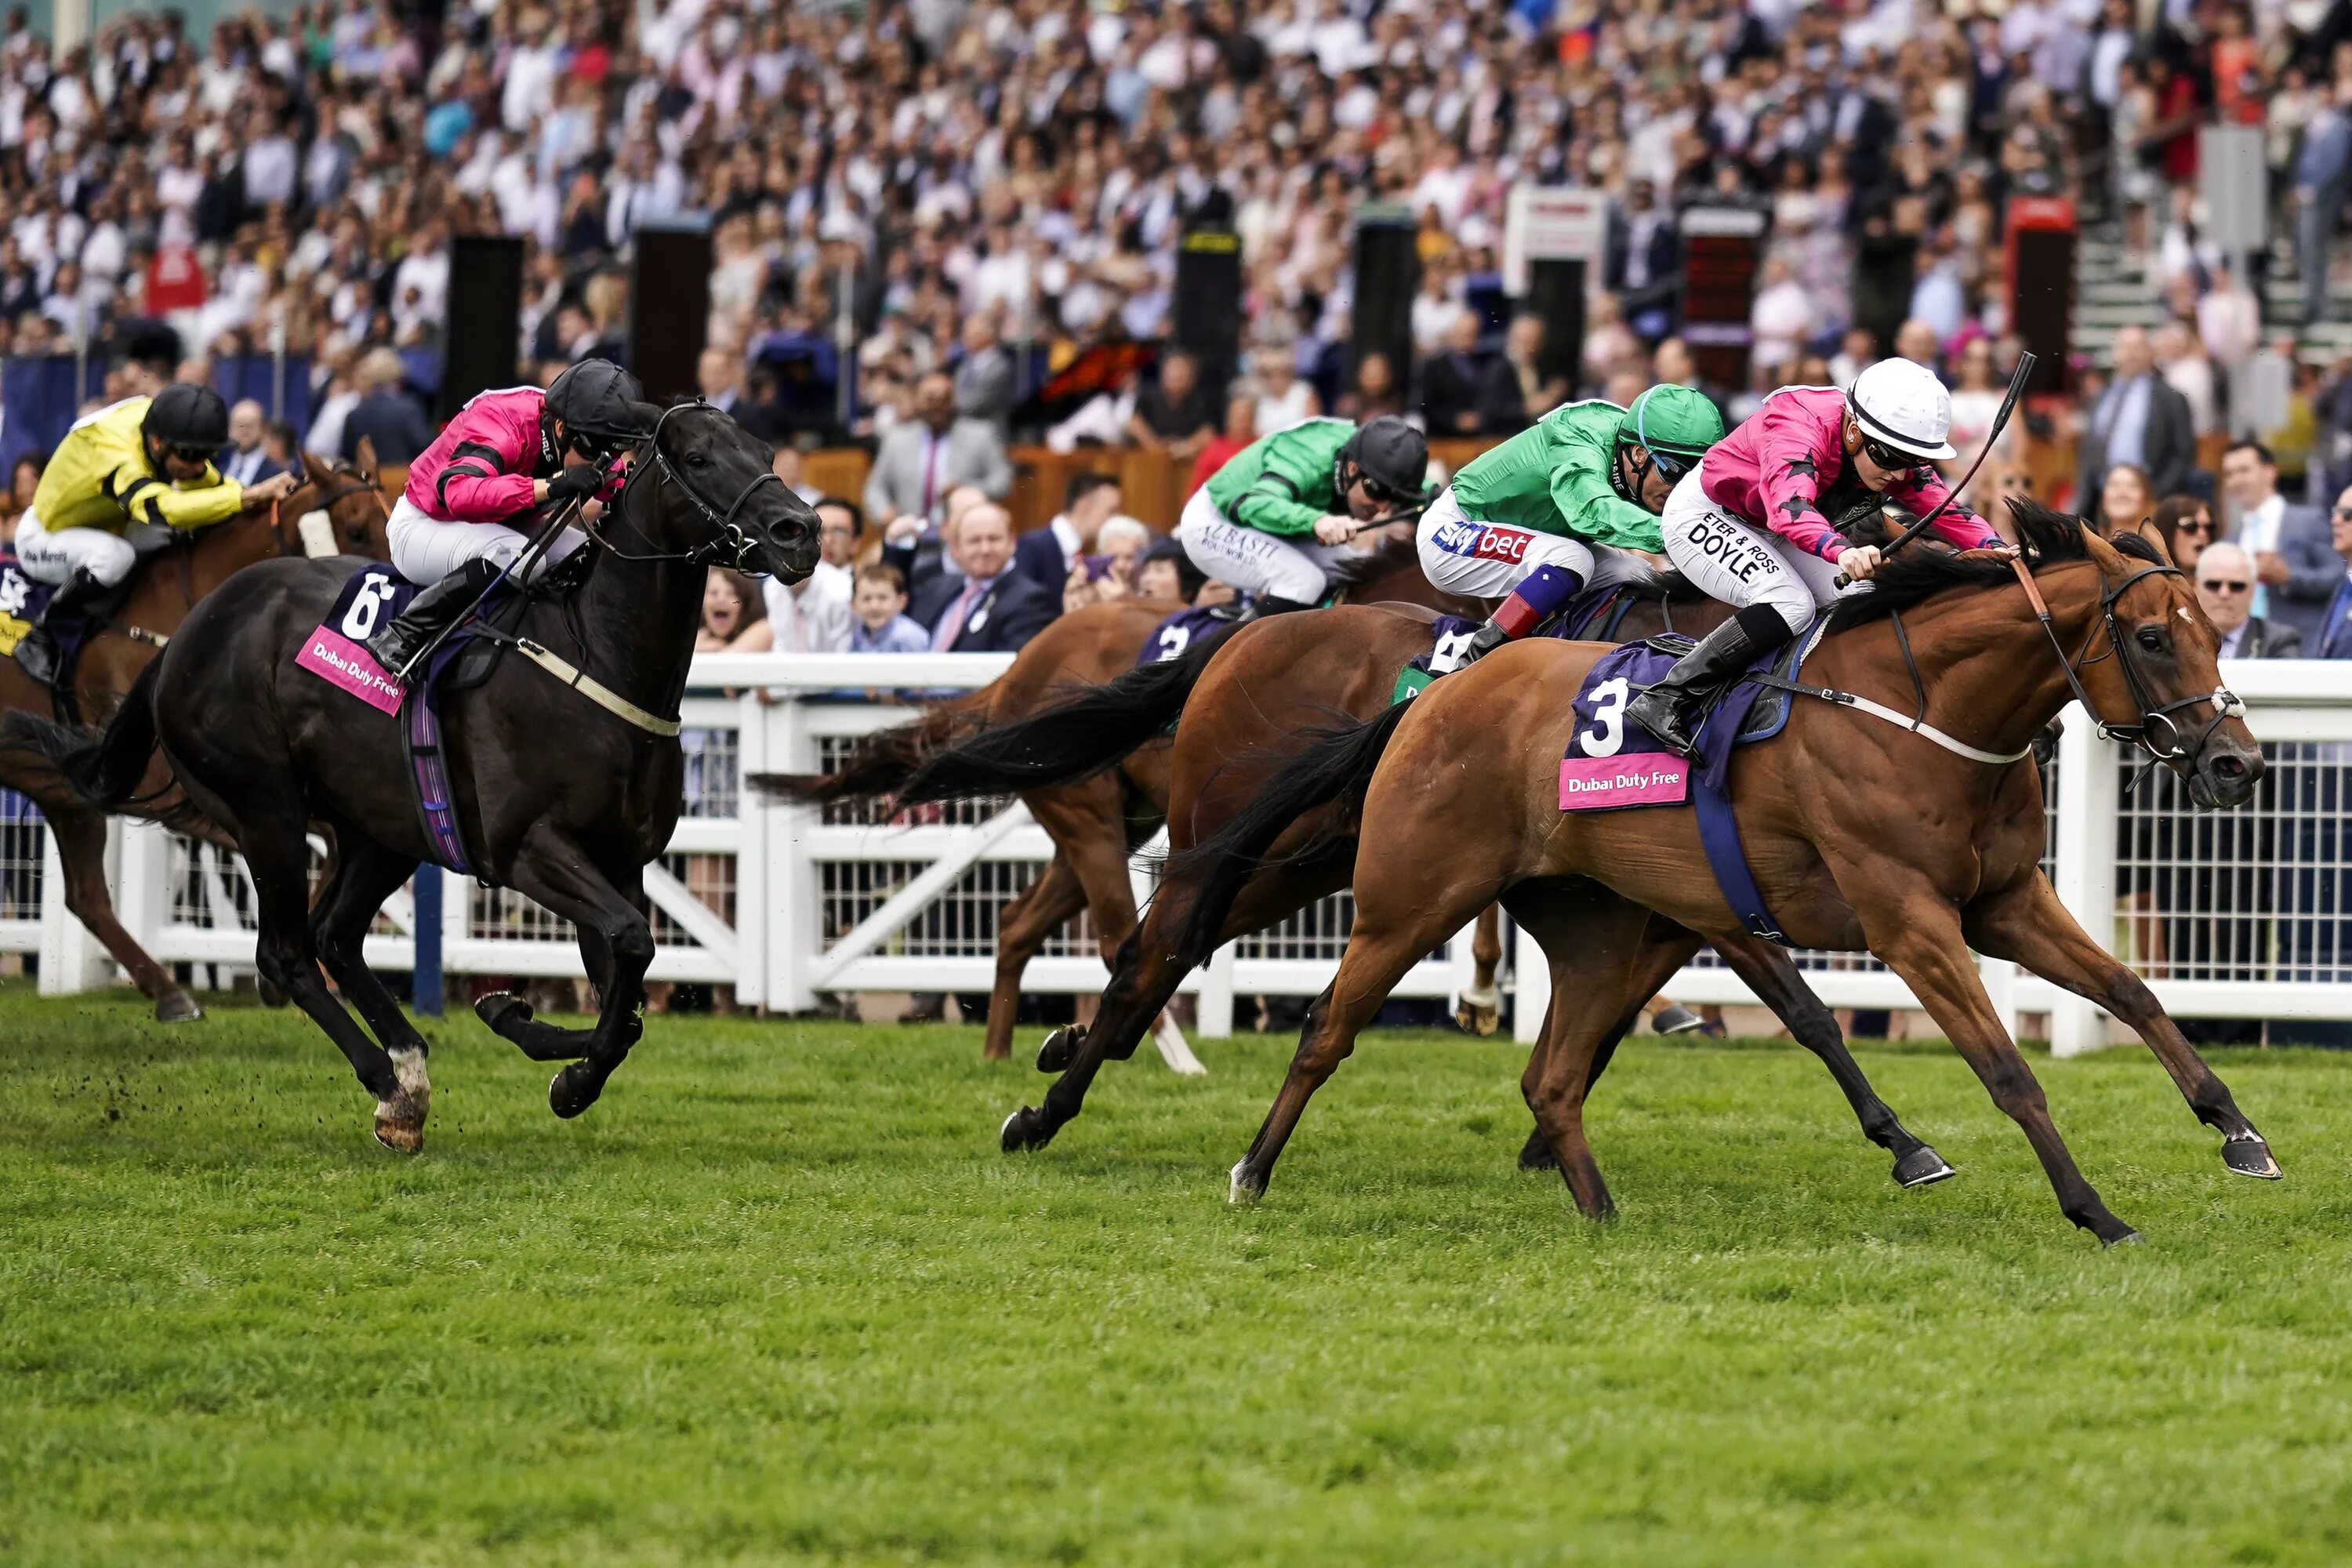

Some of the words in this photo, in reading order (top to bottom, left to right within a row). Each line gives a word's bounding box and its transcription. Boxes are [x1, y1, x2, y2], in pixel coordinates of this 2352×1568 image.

[1479, 528, 1528, 558] bet
[1688, 523, 1759, 584] DOYLE
[1703, 512, 1737, 537] ETER
[1736, 536, 1748, 546] &
[1747, 546, 1780, 574] ROSS
[342, 573, 395, 640] 6
[314, 642, 347, 671] Dubai
[347, 662, 374, 686] Duty
[373, 677, 399, 699] Free
[1580, 677, 1629, 758] 3
[1568, 777, 1613, 793] Dubai
[1615, 772, 1649, 789] Duty
[1651, 771, 1679, 786] Free
